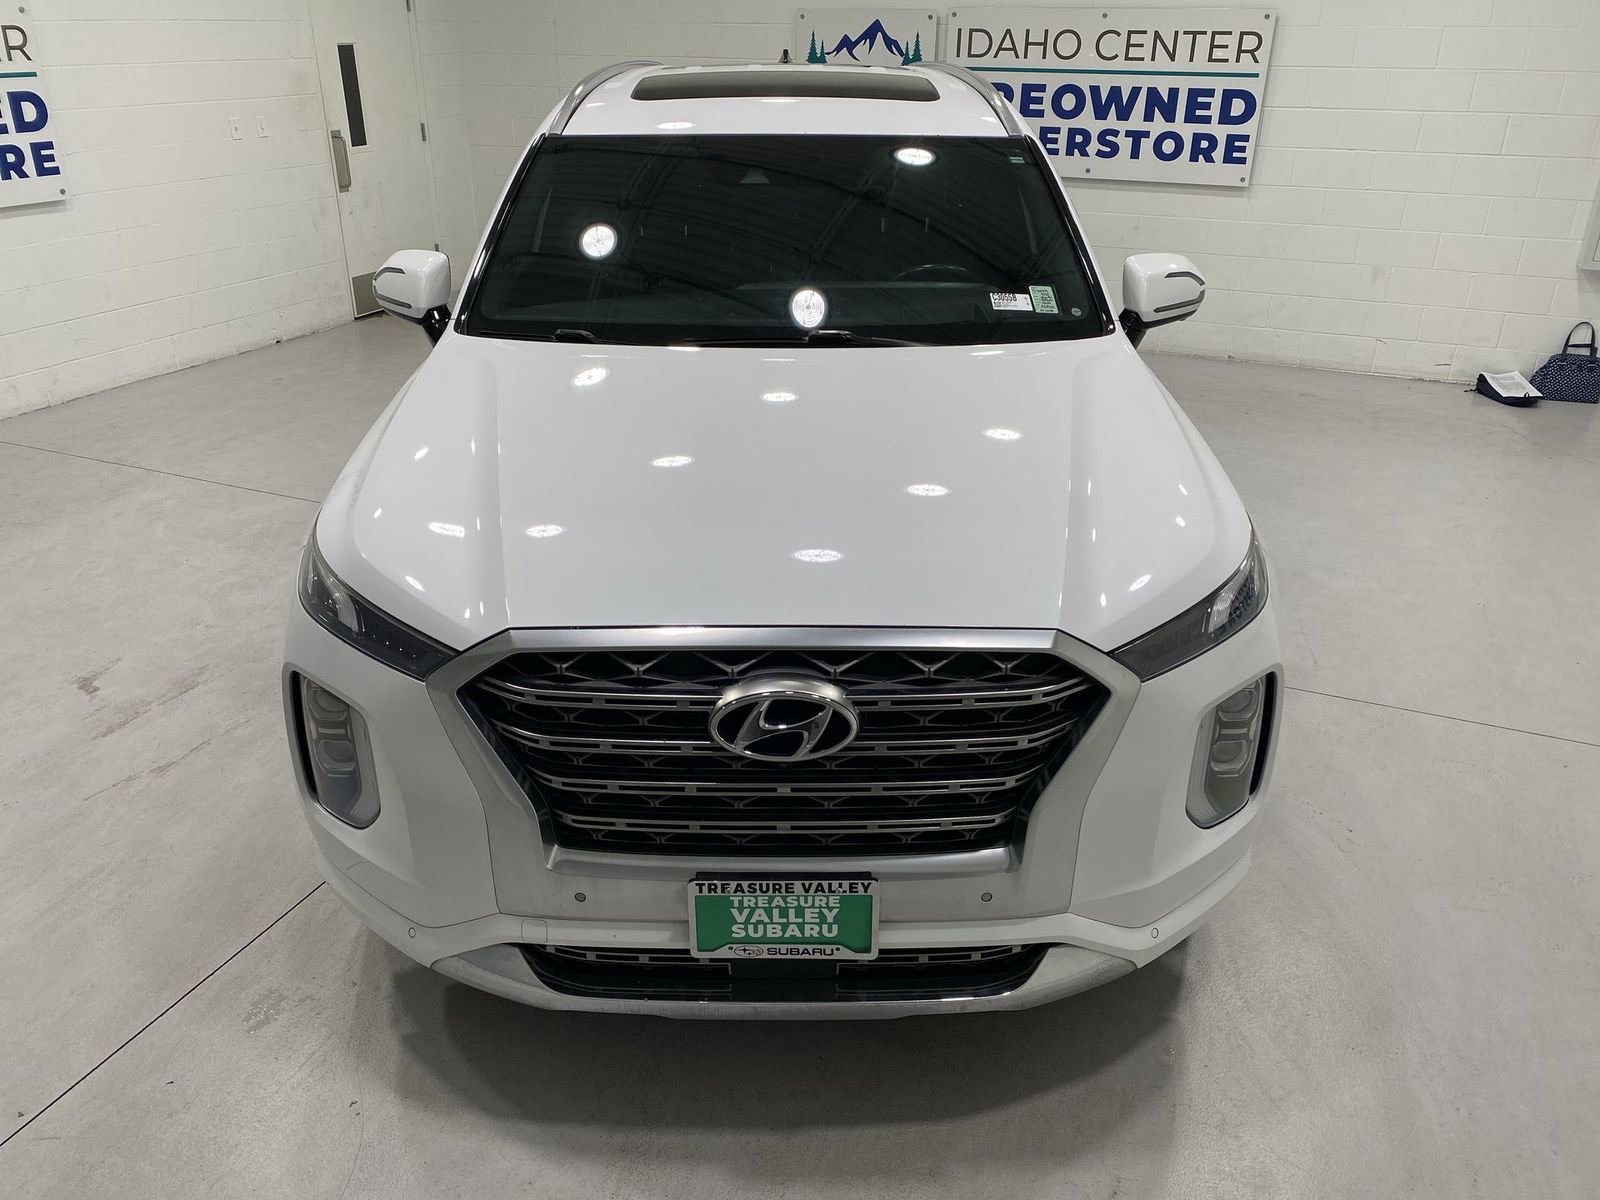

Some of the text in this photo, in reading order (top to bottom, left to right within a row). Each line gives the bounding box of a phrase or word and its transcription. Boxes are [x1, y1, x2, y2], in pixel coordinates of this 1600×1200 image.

[0, 25, 33, 62] R
[955, 27, 1263, 64] IDAHO CENTER
[695, 882, 872, 894] TREASURE VALLEY
[730, 896, 841, 907] TREASURE
[730, 908, 840, 923] VALLEY
[731, 924, 839, 938] SUBARU
[767, 947, 834, 956] SUBARU
